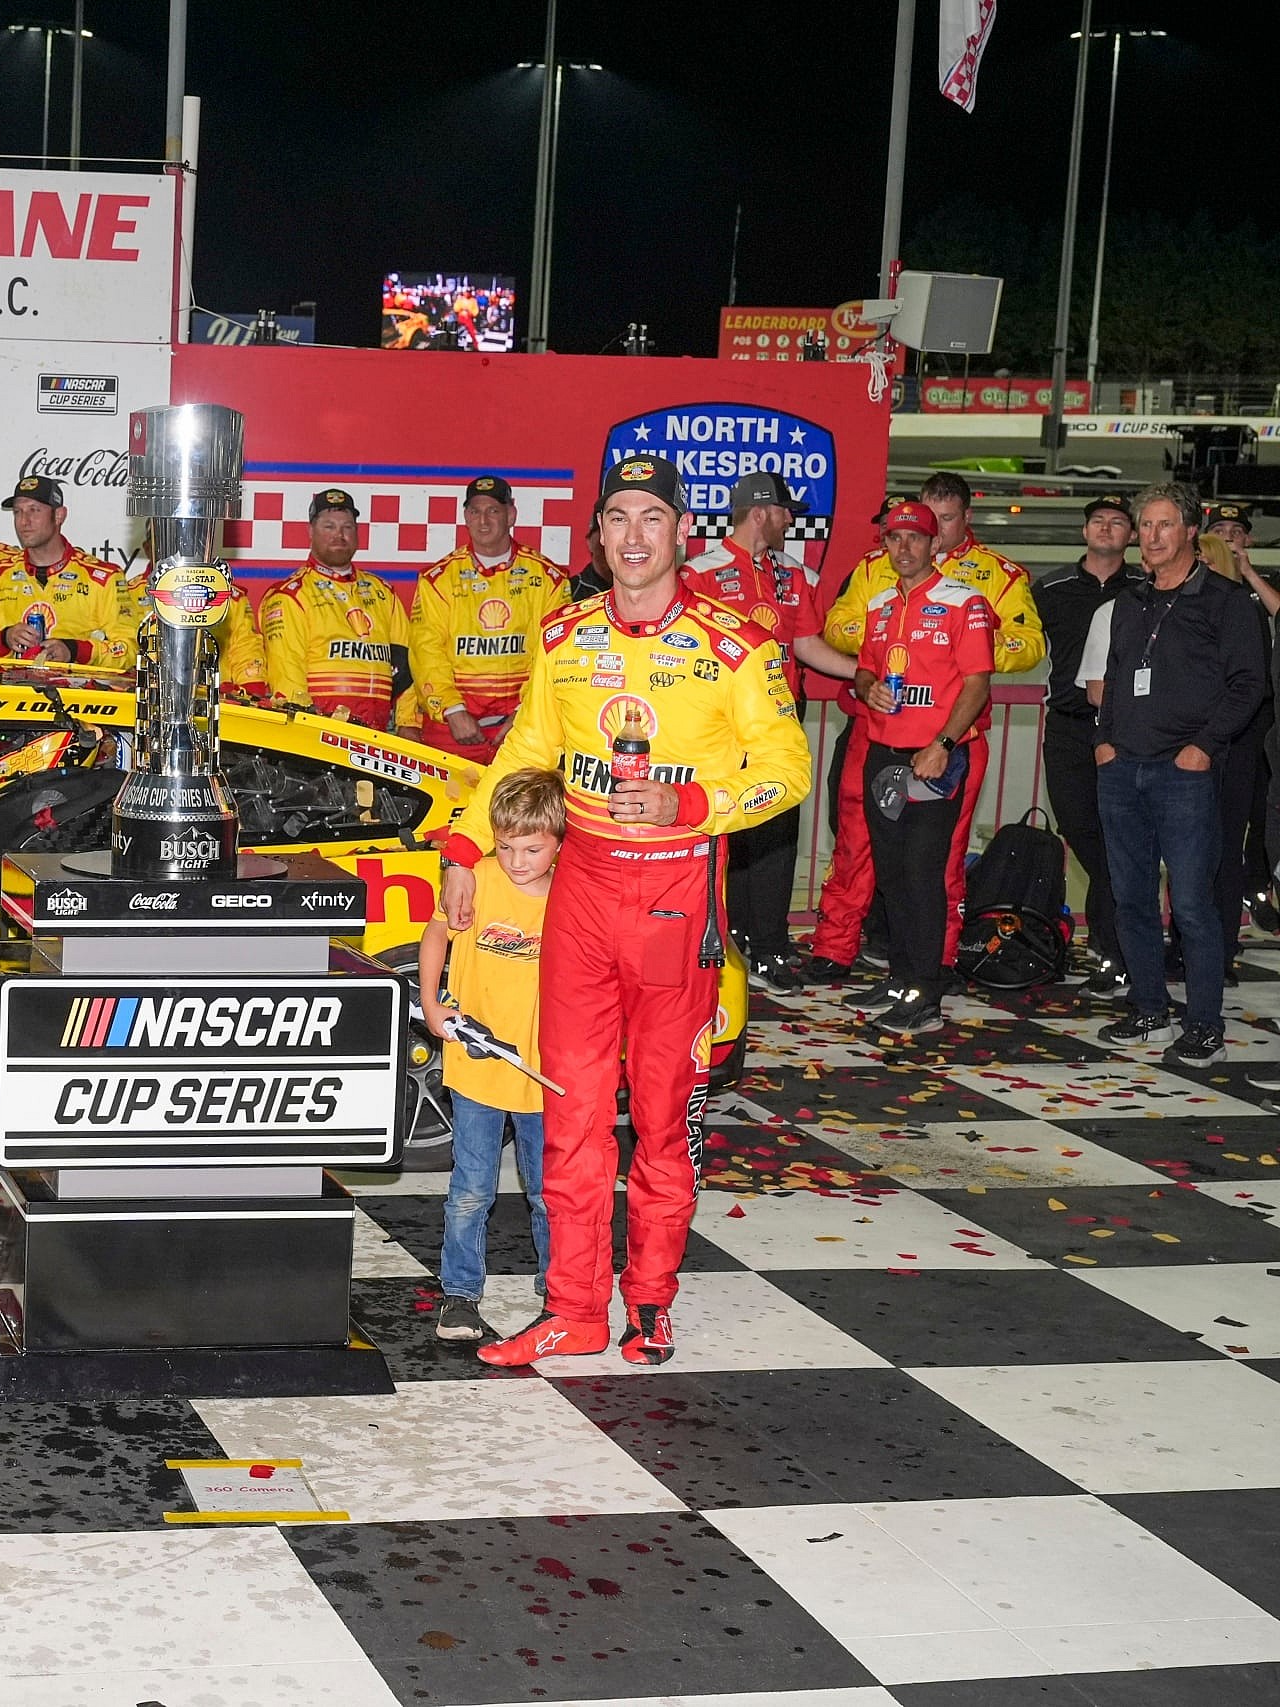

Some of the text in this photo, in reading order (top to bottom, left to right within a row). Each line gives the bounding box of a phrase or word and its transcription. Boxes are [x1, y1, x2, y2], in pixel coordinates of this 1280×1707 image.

[725, 315, 827, 331] LEADERBOARD
[63, 378, 106, 391] NASCAR
[49, 394, 106, 406] CUP SERIES
[666, 415, 779, 443] NORTH
[1122, 422, 1149, 434] CUP
[19, 447, 129, 487] Coca-Cola
[181, 614, 208, 623] RACE
[457, 635, 526, 656] PENNZOIL
[666, 633, 693, 648] Ford
[719, 639, 742, 658] OMP
[321, 731, 449, 782] DISCOUNT
[357, 756, 413, 781] TIRE
[149, 787, 168, 807] CUP
[743, 786, 779, 811] PENNZOIL
[160, 840, 221, 860] BUSCH
[610, 849, 642, 860] JOEY
[47, 895, 88, 911] BUSCH
[129, 892, 180, 910] Coca-Cola
[211, 894, 273, 908] GEICO
[300, 891, 356, 911] xfinity
[128, 997, 343, 1048] NASCAR
[54, 1077, 343, 1125] CUP SERIES
